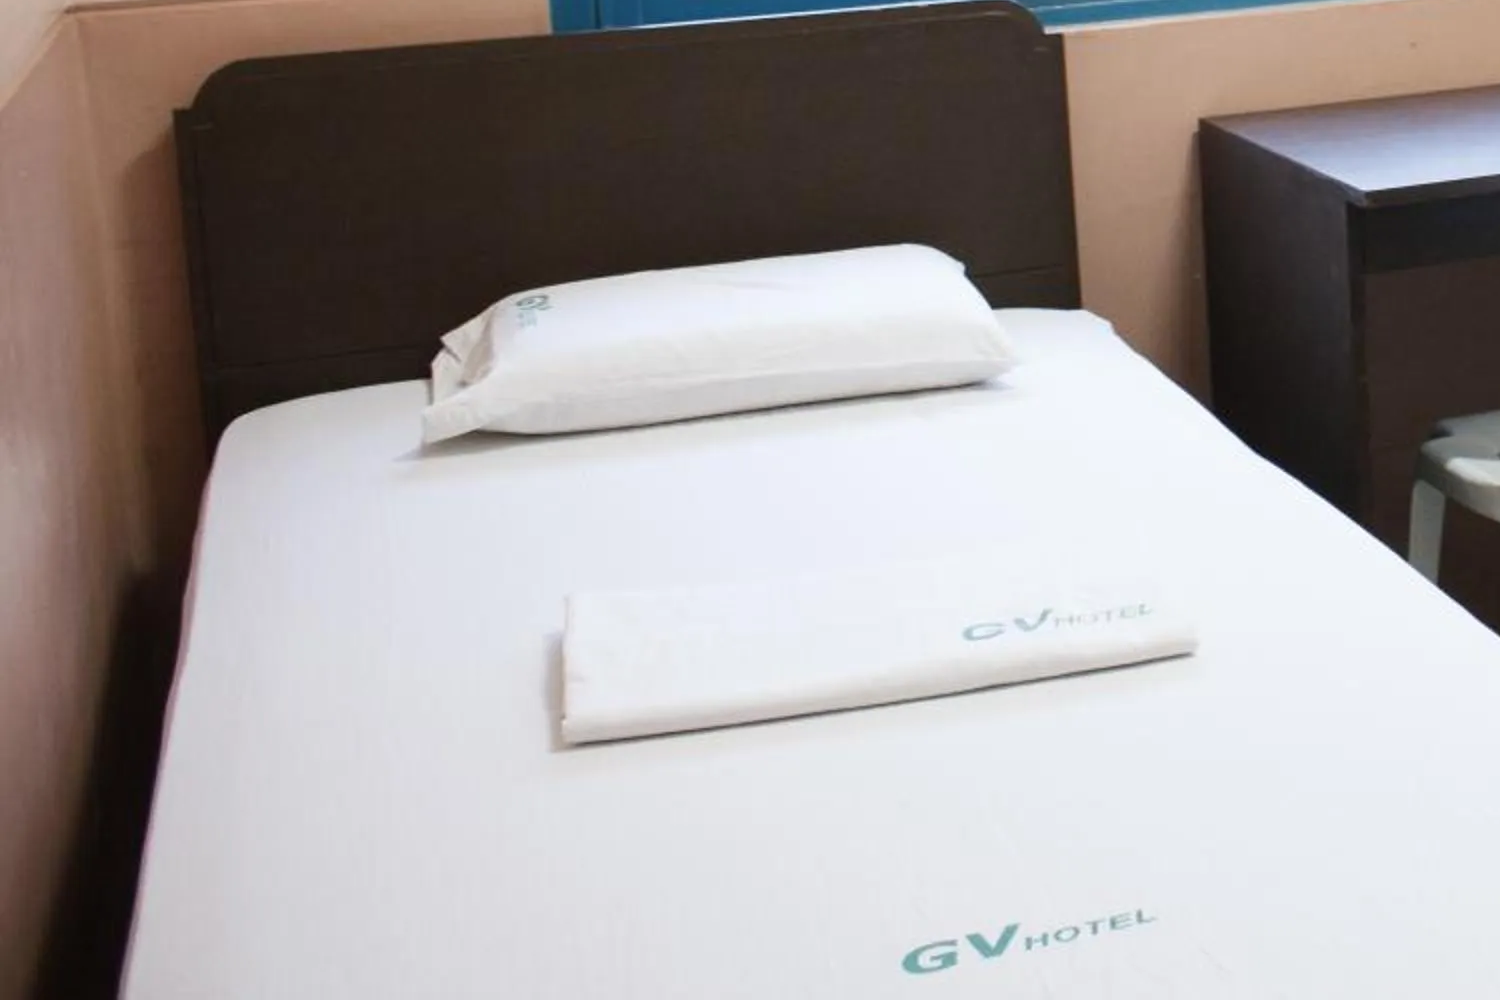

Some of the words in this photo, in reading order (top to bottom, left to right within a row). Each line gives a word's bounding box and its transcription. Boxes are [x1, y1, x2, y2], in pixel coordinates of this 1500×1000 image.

[1053, 602, 1153, 629] HOTEL
[902, 922, 1020, 974] GV
[1024, 907, 1157, 951] HOTEL
